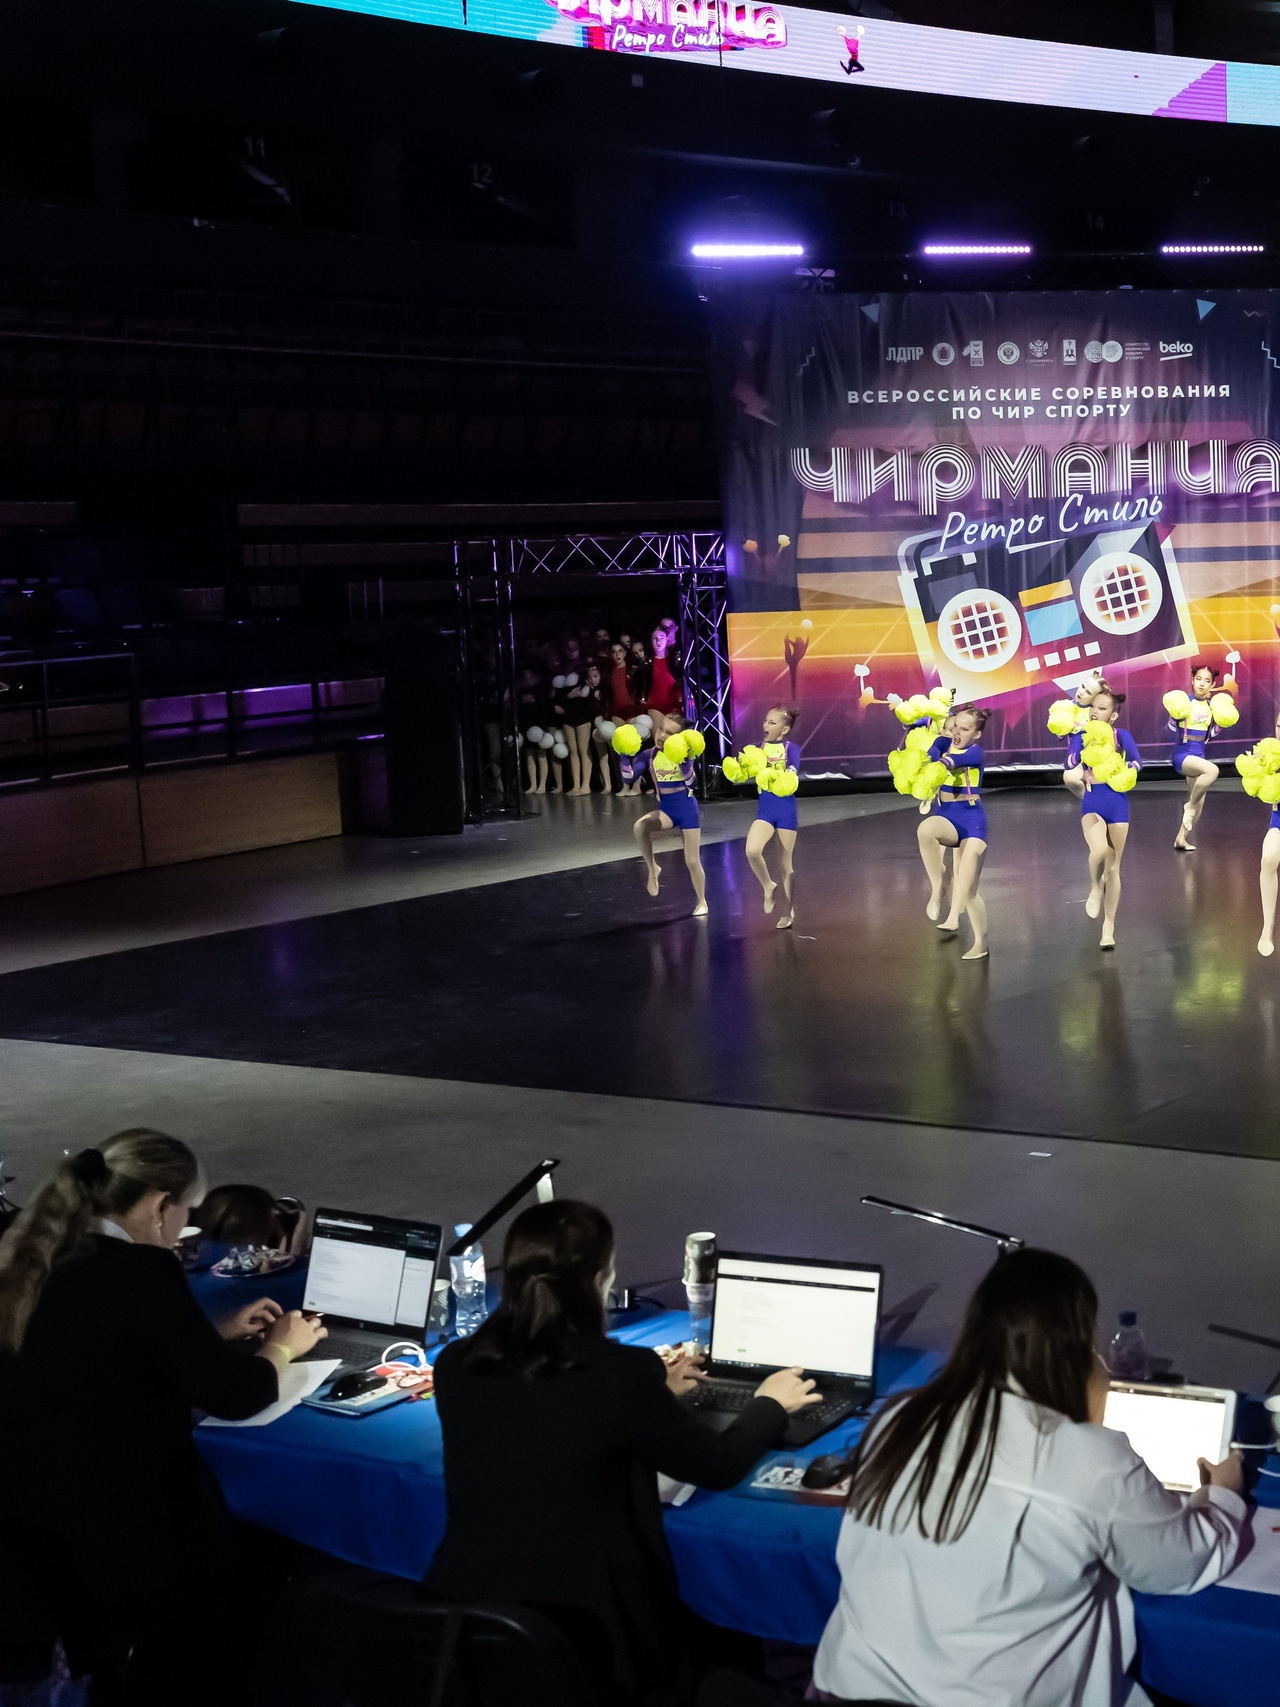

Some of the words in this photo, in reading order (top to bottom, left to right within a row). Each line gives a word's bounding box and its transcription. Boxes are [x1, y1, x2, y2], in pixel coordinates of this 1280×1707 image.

[886, 346, 924, 363] ЛДПР
[1159, 341, 1194, 354] beko
[847, 385, 1042, 404] ВСЕРОССИЙСКИЕ
[1052, 384, 1231, 401] СОРЕВНОВАНИЯ
[952, 406, 982, 420] ПО
[991, 405, 1036, 420] ЧИР
[1045, 403, 1132, 419] СПОРТУ
[938, 511, 1046, 553] Ретро
[1057, 493, 1164, 534] Стиль
